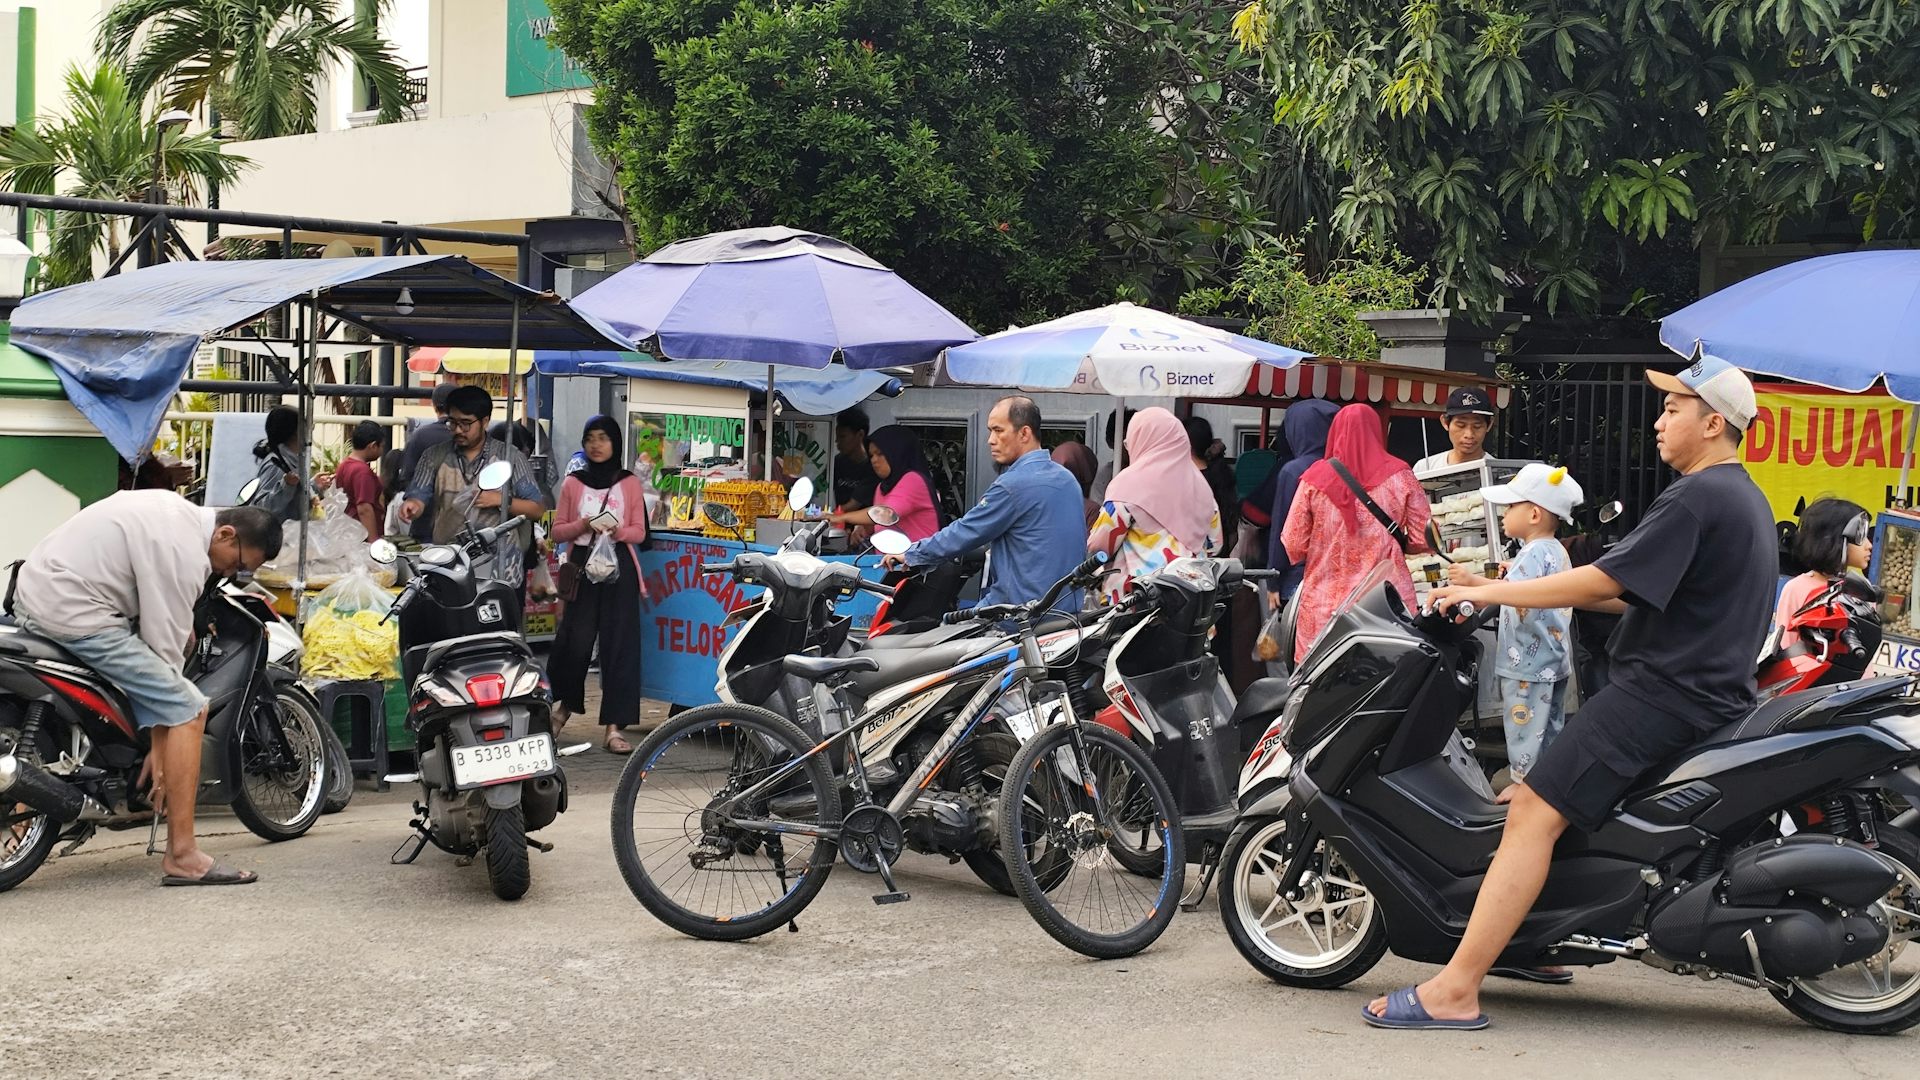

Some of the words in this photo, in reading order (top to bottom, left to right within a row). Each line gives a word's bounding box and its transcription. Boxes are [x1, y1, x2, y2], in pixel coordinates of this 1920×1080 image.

[528, 16, 559, 40] YAYA
[1119, 342, 1210, 353] Biznet
[1166, 372, 1214, 386] Biznet
[664, 414, 744, 447] BANDUNG
[1745, 405, 1916, 469] DIJUAL
[1886, 485, 1920, 509] H
[655, 616, 726, 659] TELOR
[916, 688, 990, 782] ATLANTIS
[456, 752, 465, 766] B
[475, 745, 512, 763] 5338
[518, 739, 544, 756] KFP
